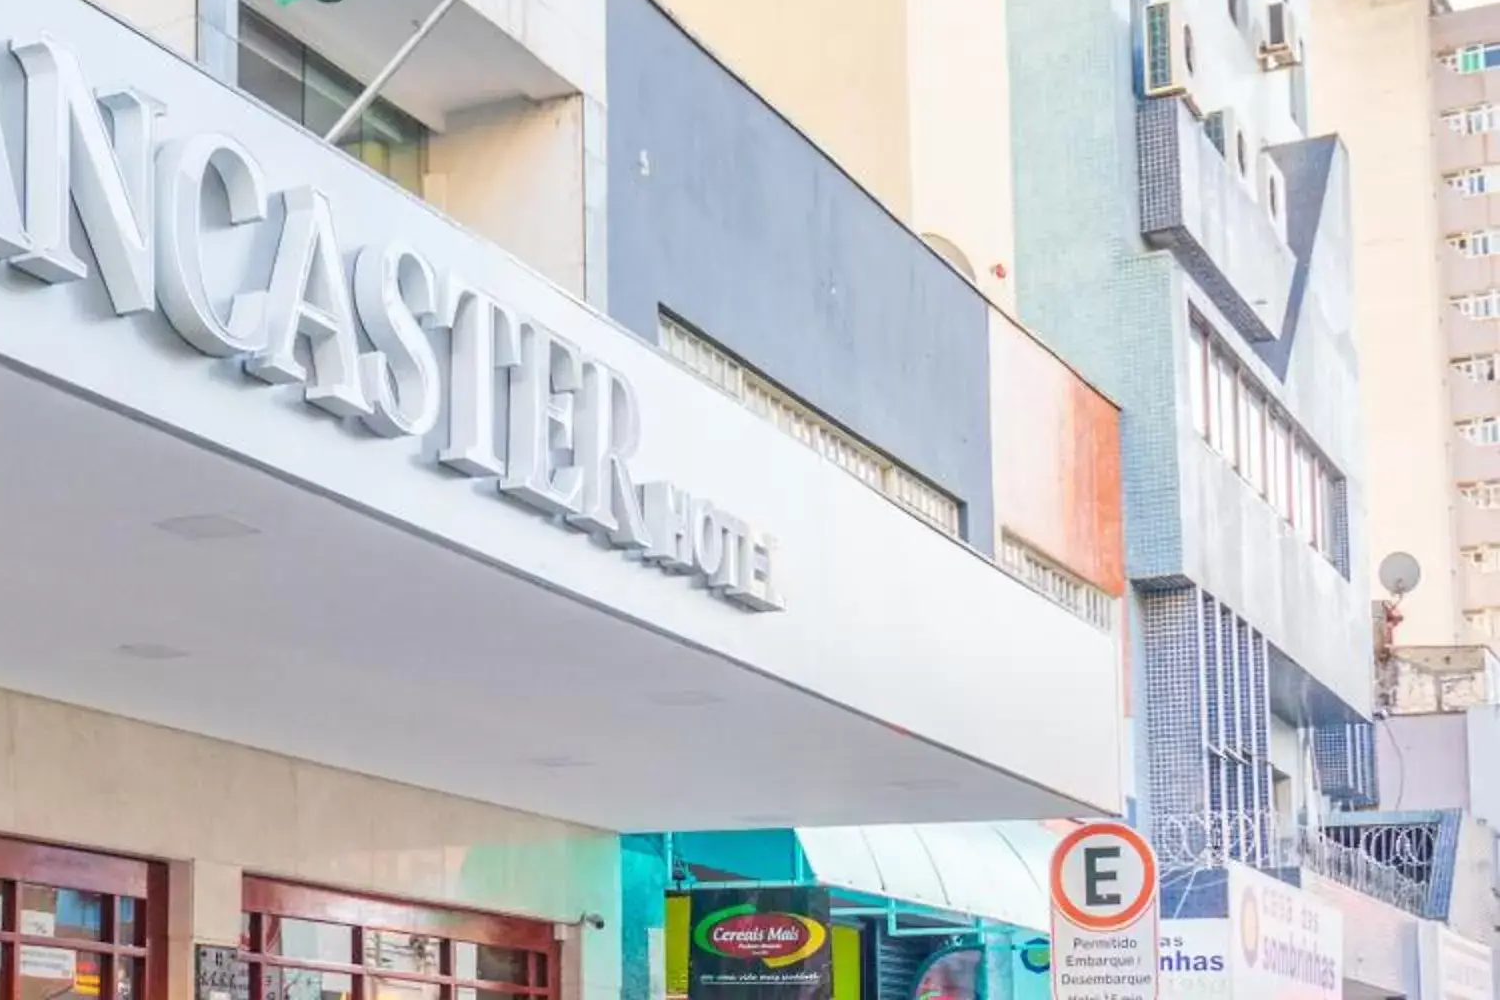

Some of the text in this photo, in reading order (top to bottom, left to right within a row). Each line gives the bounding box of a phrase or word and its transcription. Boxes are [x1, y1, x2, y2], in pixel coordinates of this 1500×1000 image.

[1084, 847, 1121, 906] E
[712, 925, 798, 941] Cereais Mais
[1073, 937, 1137, 949] Permitido
[1065, 955, 1135, 967] Embarque
[1061, 973, 1151, 985] Desembarque
